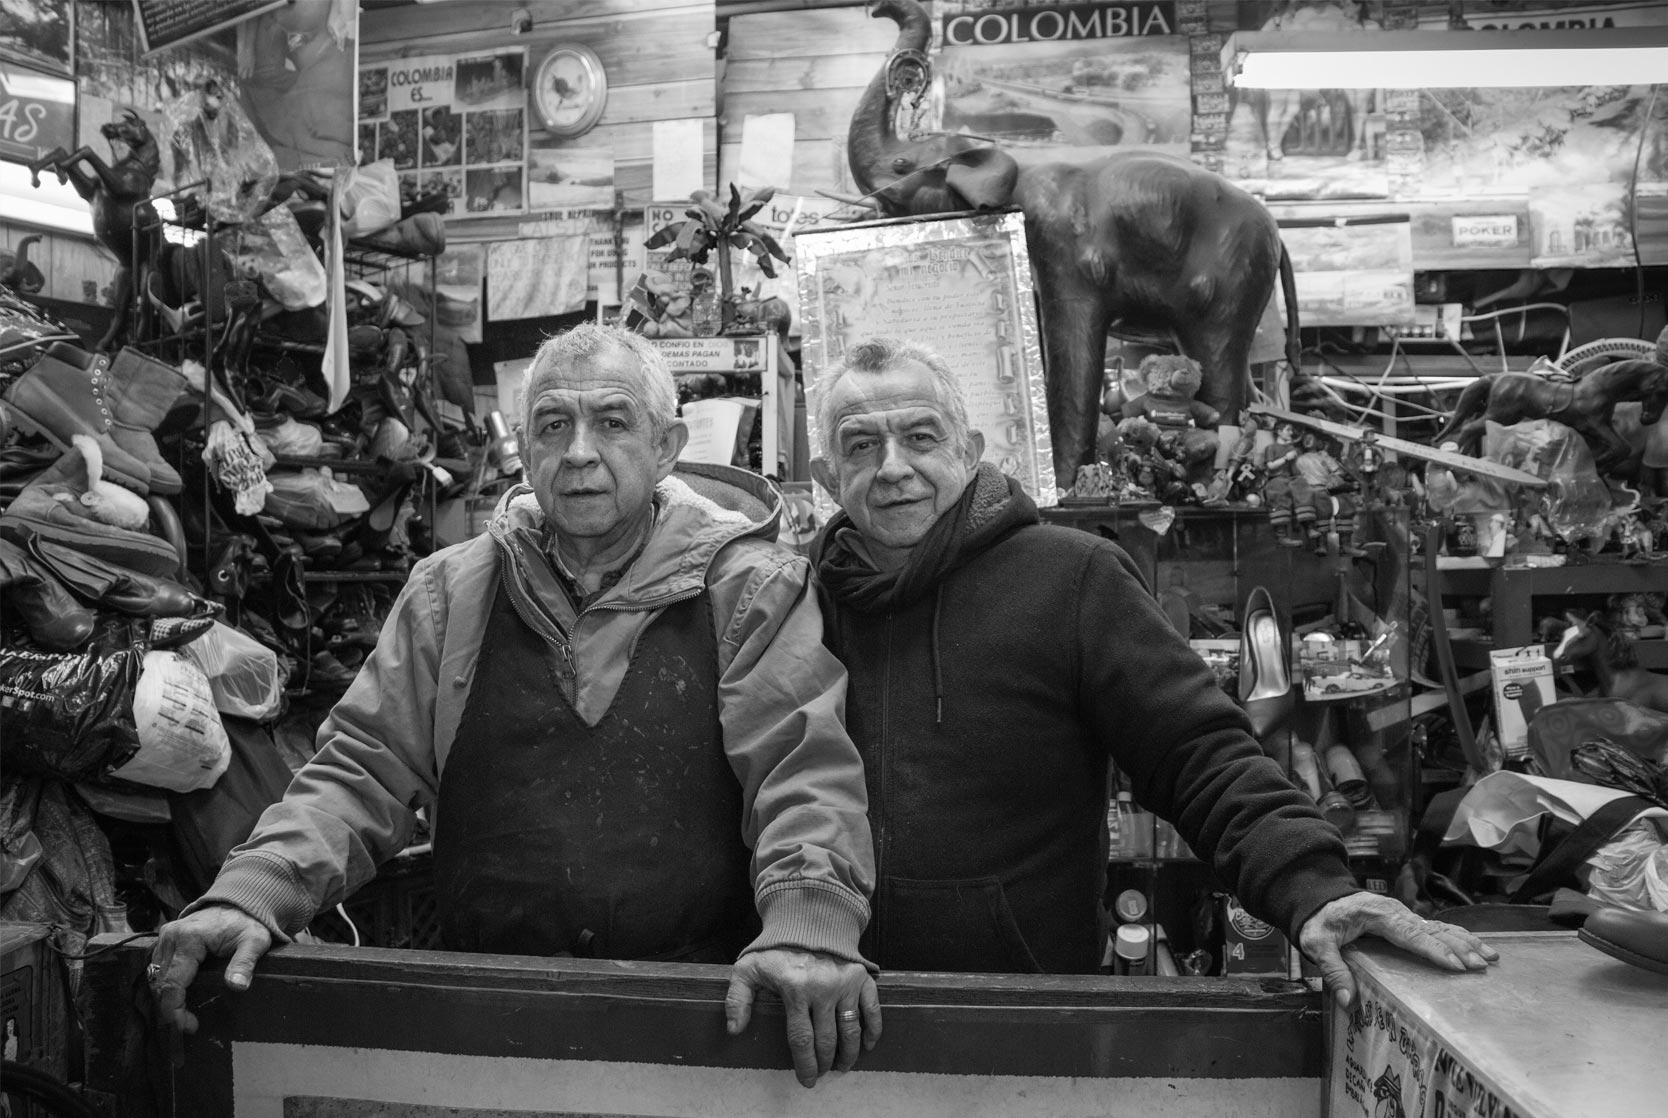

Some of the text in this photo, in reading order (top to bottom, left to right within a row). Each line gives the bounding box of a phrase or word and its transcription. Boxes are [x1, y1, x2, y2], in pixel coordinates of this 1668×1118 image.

[946, 4, 1172, 46] COLOMBIA
[390, 65, 453, 87] COLOMBIA
[651, 209, 674, 222] NO
[1458, 225, 1513, 236] POKER
[692, 350, 721, 358] PAGAN
[667, 359, 709, 367] CONTADO
[1231, 942, 1245, 961] 4
